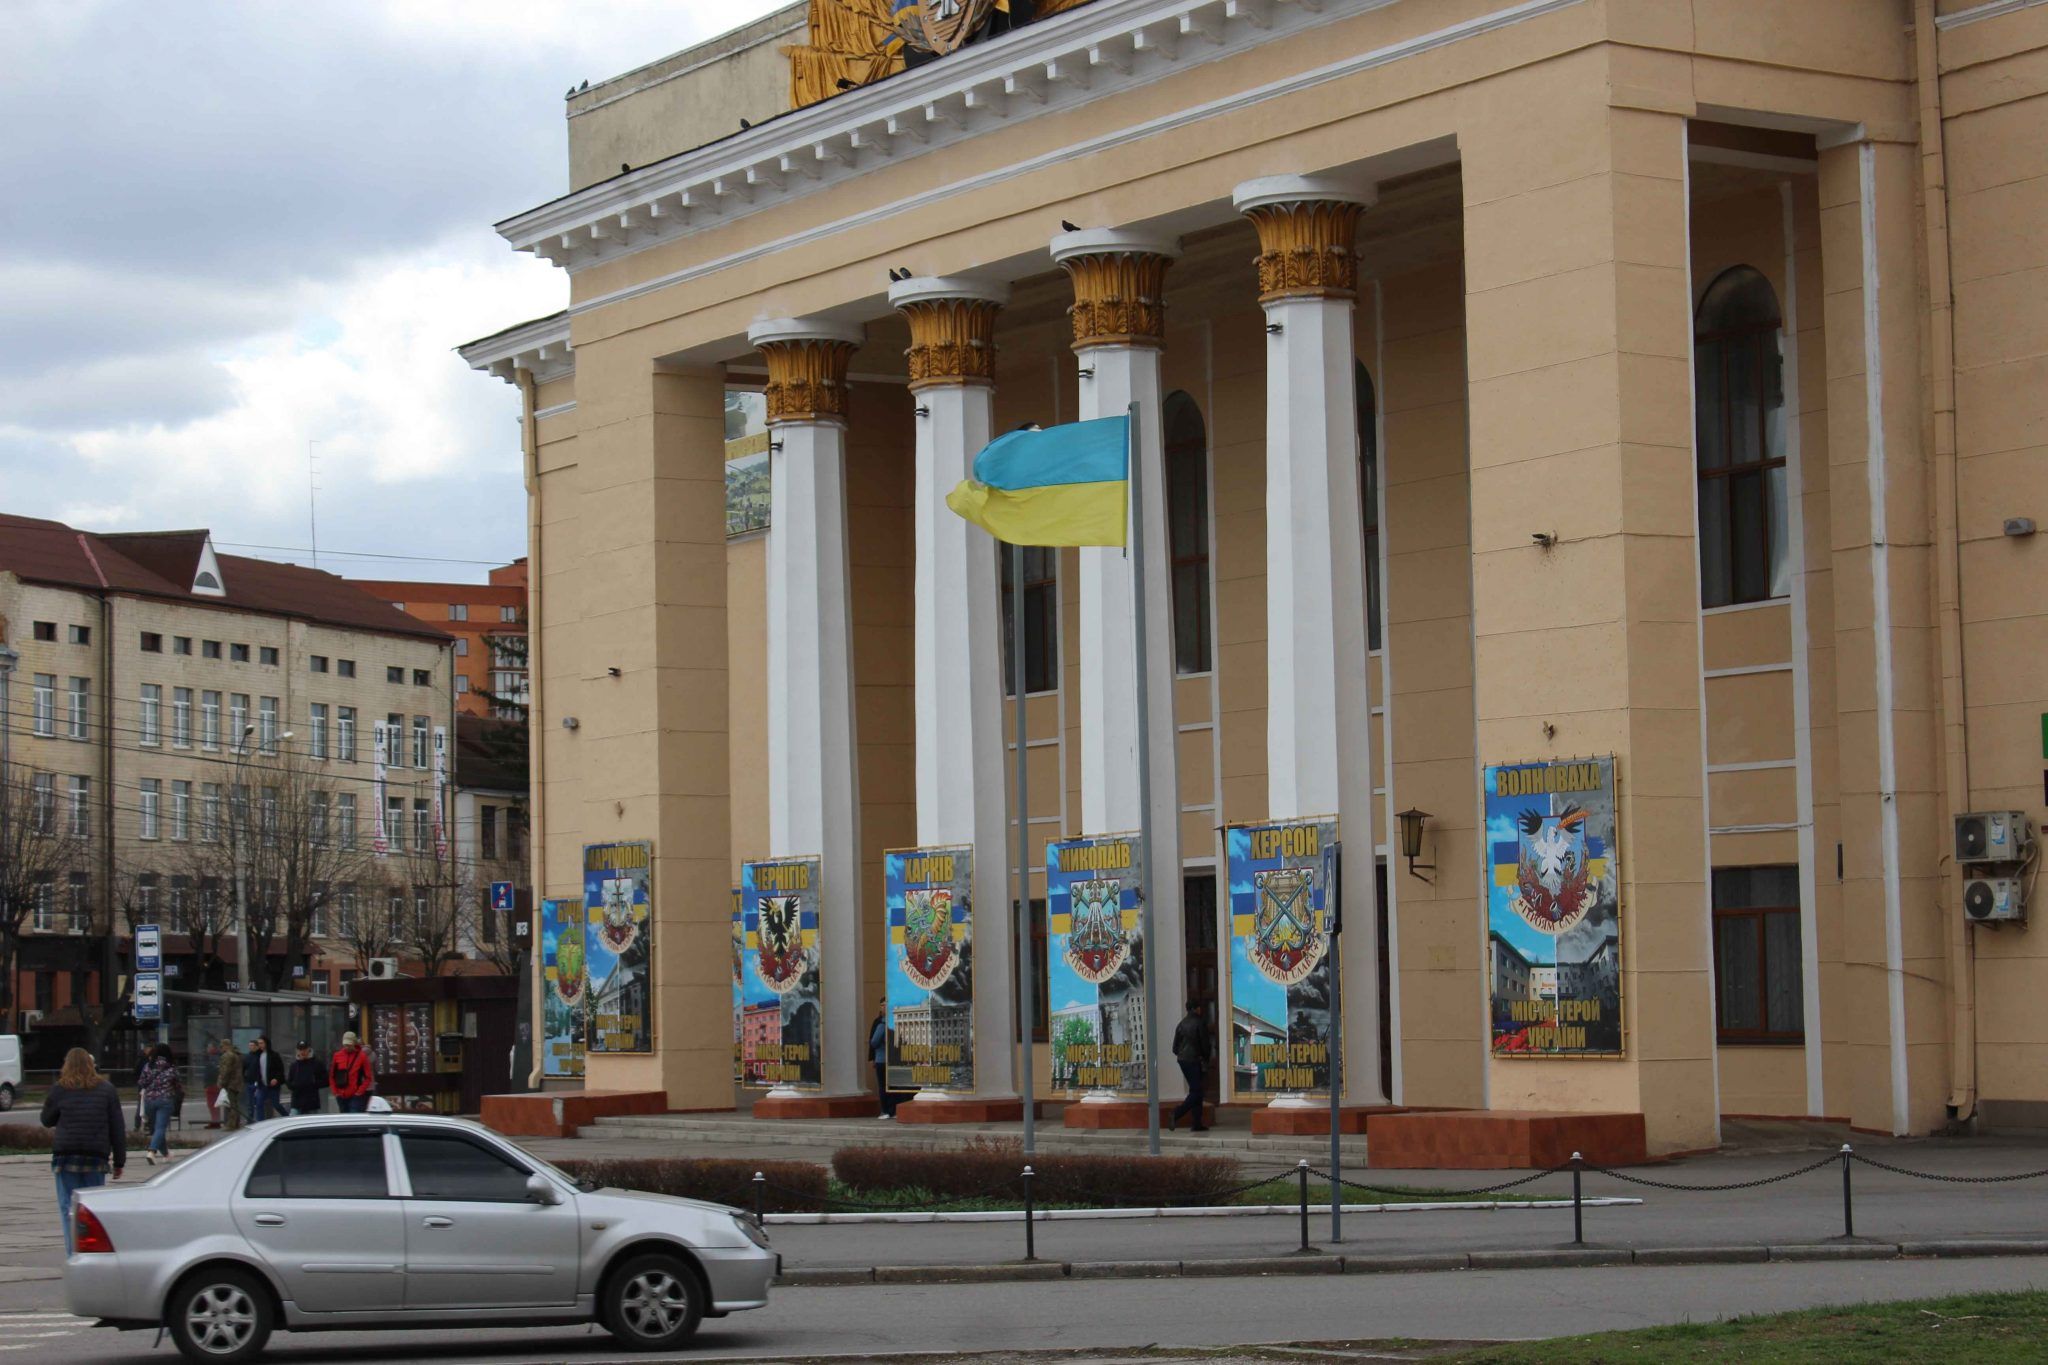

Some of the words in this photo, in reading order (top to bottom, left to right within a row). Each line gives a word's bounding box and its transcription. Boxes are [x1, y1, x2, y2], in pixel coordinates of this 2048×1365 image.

[1497, 763, 1602, 797] ВОЛНОВАХА
[1251, 826, 1318, 860] ХЕРСОН
[587, 846, 647, 870] МАРІУПОЛЬ
[1059, 840, 1131, 872] МИКОЛАЇВ
[754, 865, 809, 891] ЧЕРНІГІВ
[905, 855, 953, 883] ХАРКІВ
[1257, 954, 1288, 981] ГЕРОЯМ
[1511, 995, 1600, 1021] МІСТО-ГЕРОЙ
[1528, 1023, 1586, 1048] УКРАЇНИ
[756, 1041, 810, 1061] МІСТО-ГЕРОЙ
[901, 1043, 960, 1062] МІСТО-ГЕРОЙ
[1067, 1041, 1132, 1063] МІСТО-ГЕРОЙ
[1251, 1040, 1326, 1063] МІСТО-ГЕРОЙ
[912, 1065, 951, 1083] УКРАЇНИ
[1078, 1066, 1121, 1086] УКРАЇНИ
[1264, 1065, 1314, 1088] УКРАЇНИ
